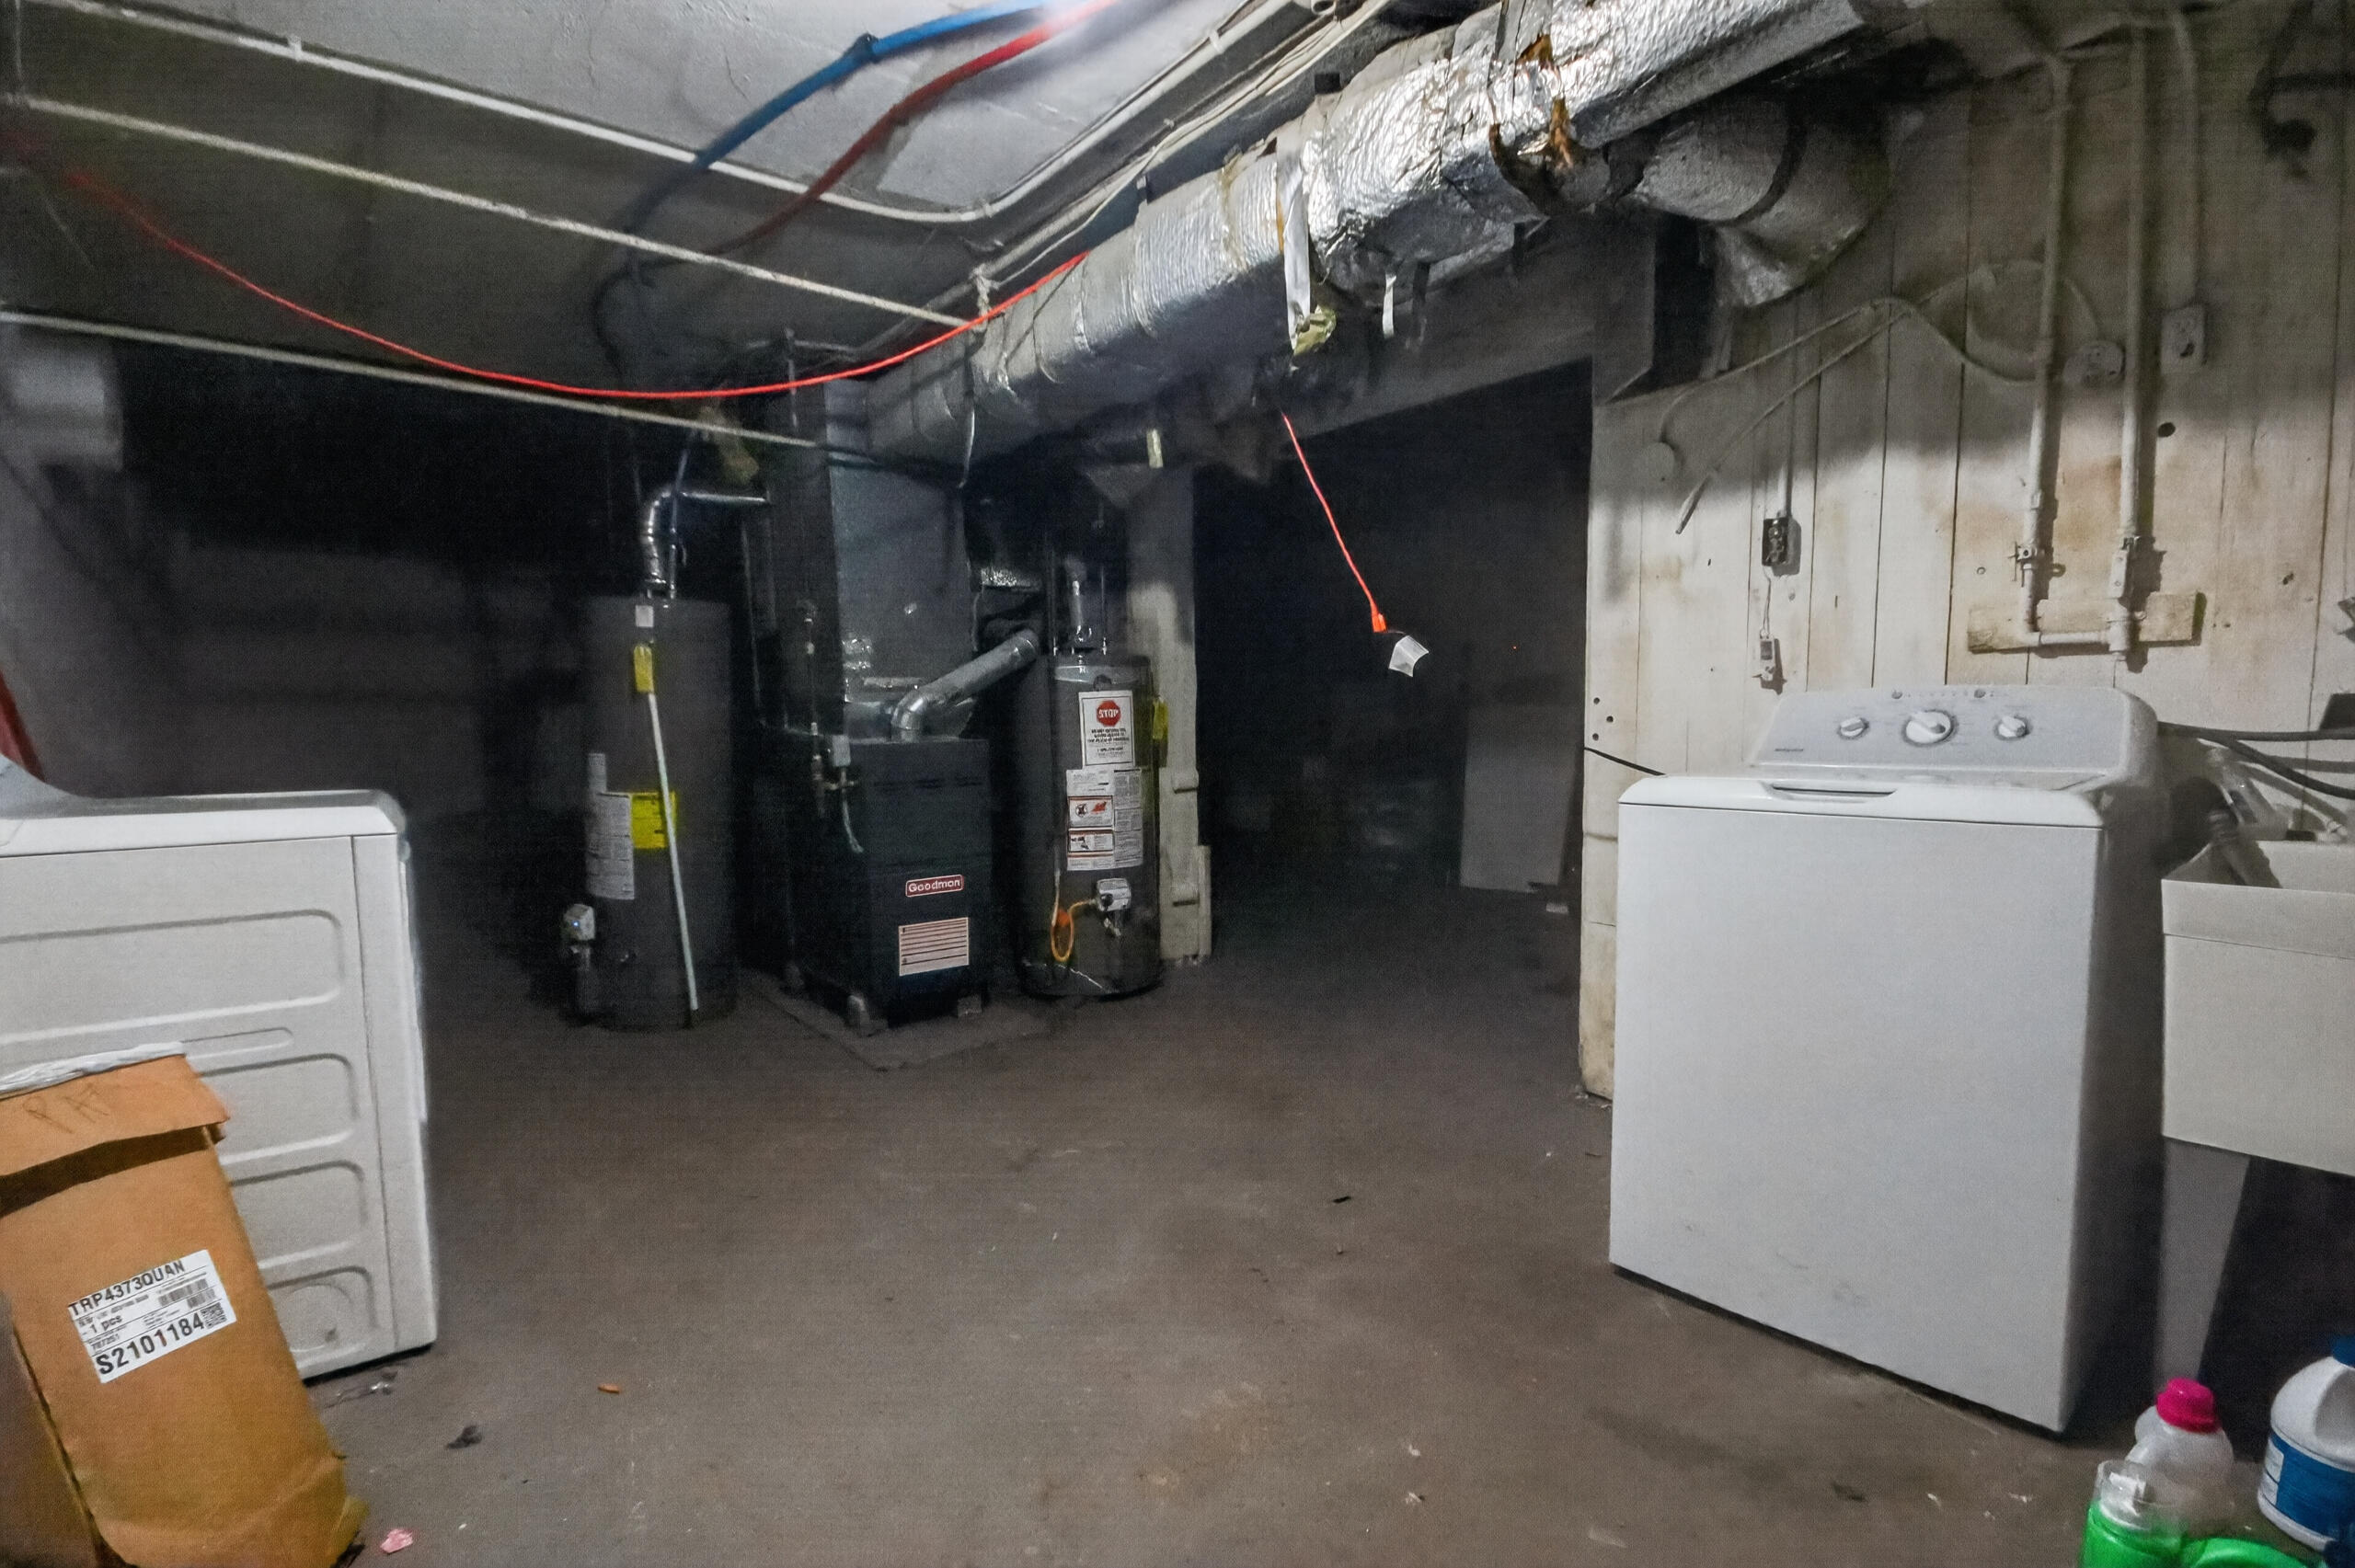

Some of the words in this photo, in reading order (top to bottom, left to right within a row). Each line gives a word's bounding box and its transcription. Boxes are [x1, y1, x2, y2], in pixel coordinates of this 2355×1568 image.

[1098, 709, 1119, 718] STOP
[909, 879, 960, 893] Goodman
[101, 1315, 122, 1331] pcs
[96, 1312, 204, 1375] S2101184
